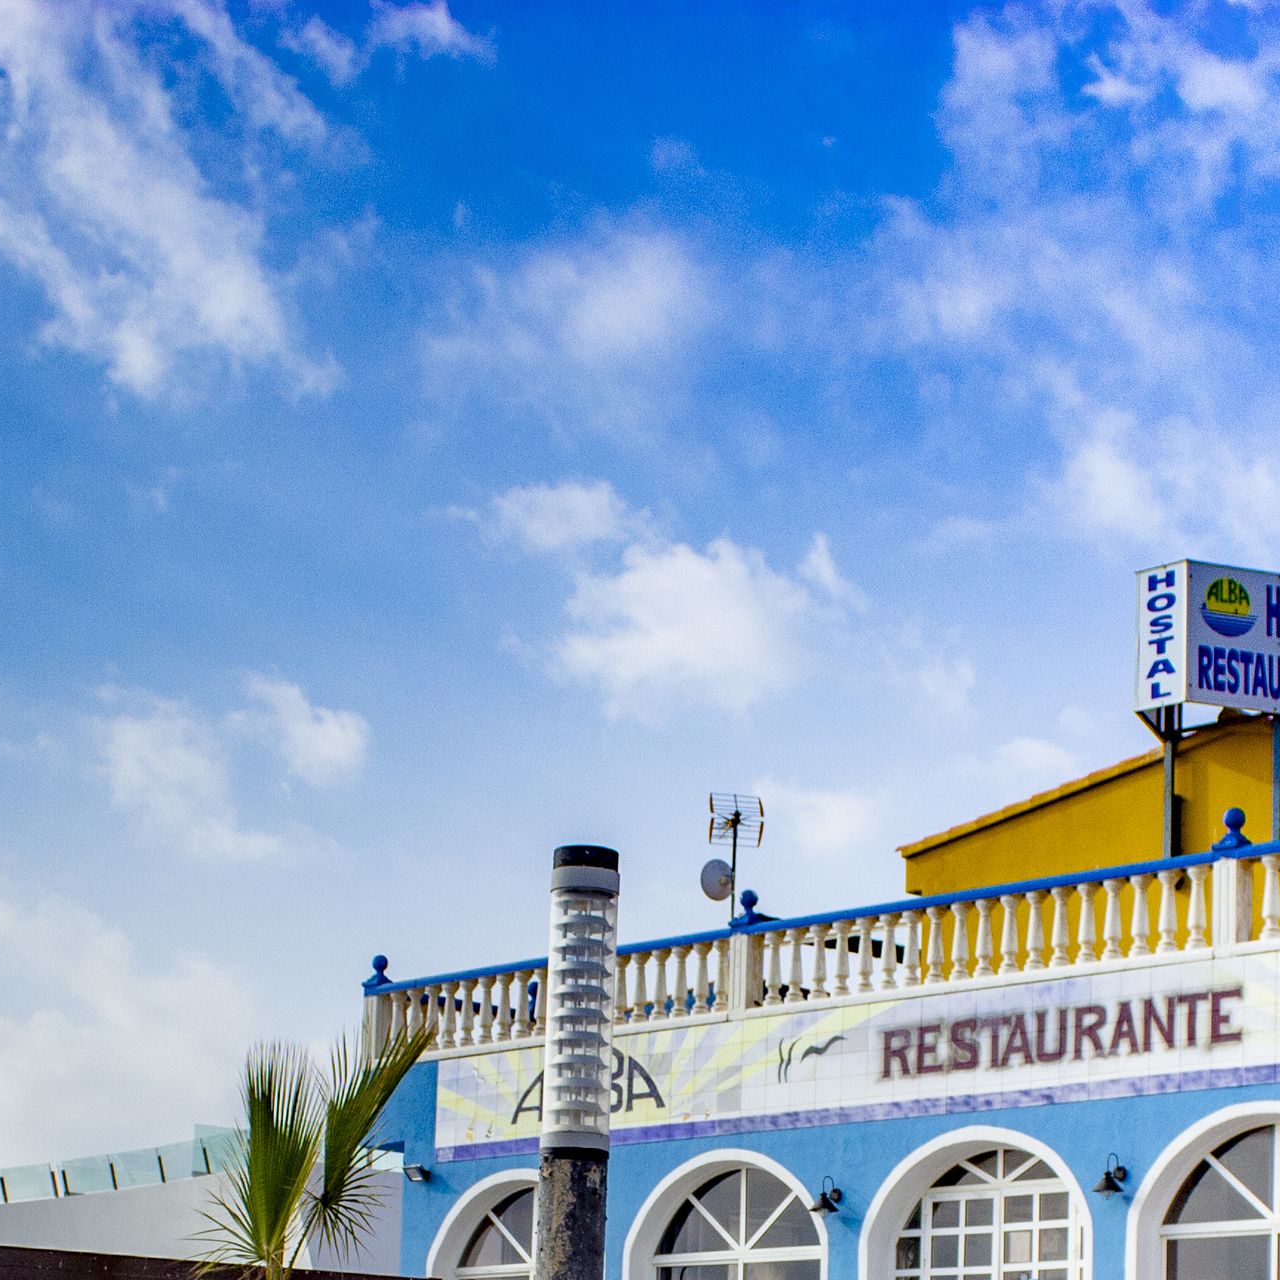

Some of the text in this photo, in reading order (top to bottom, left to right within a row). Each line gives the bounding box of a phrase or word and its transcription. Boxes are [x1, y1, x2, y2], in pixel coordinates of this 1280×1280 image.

[1146, 570, 1176, 699] HOSTAL
[1207, 578, 1250, 606] ALBA
[881, 988, 1243, 1079] RESTAURANTE
[511, 1046, 666, 1125] ABA
